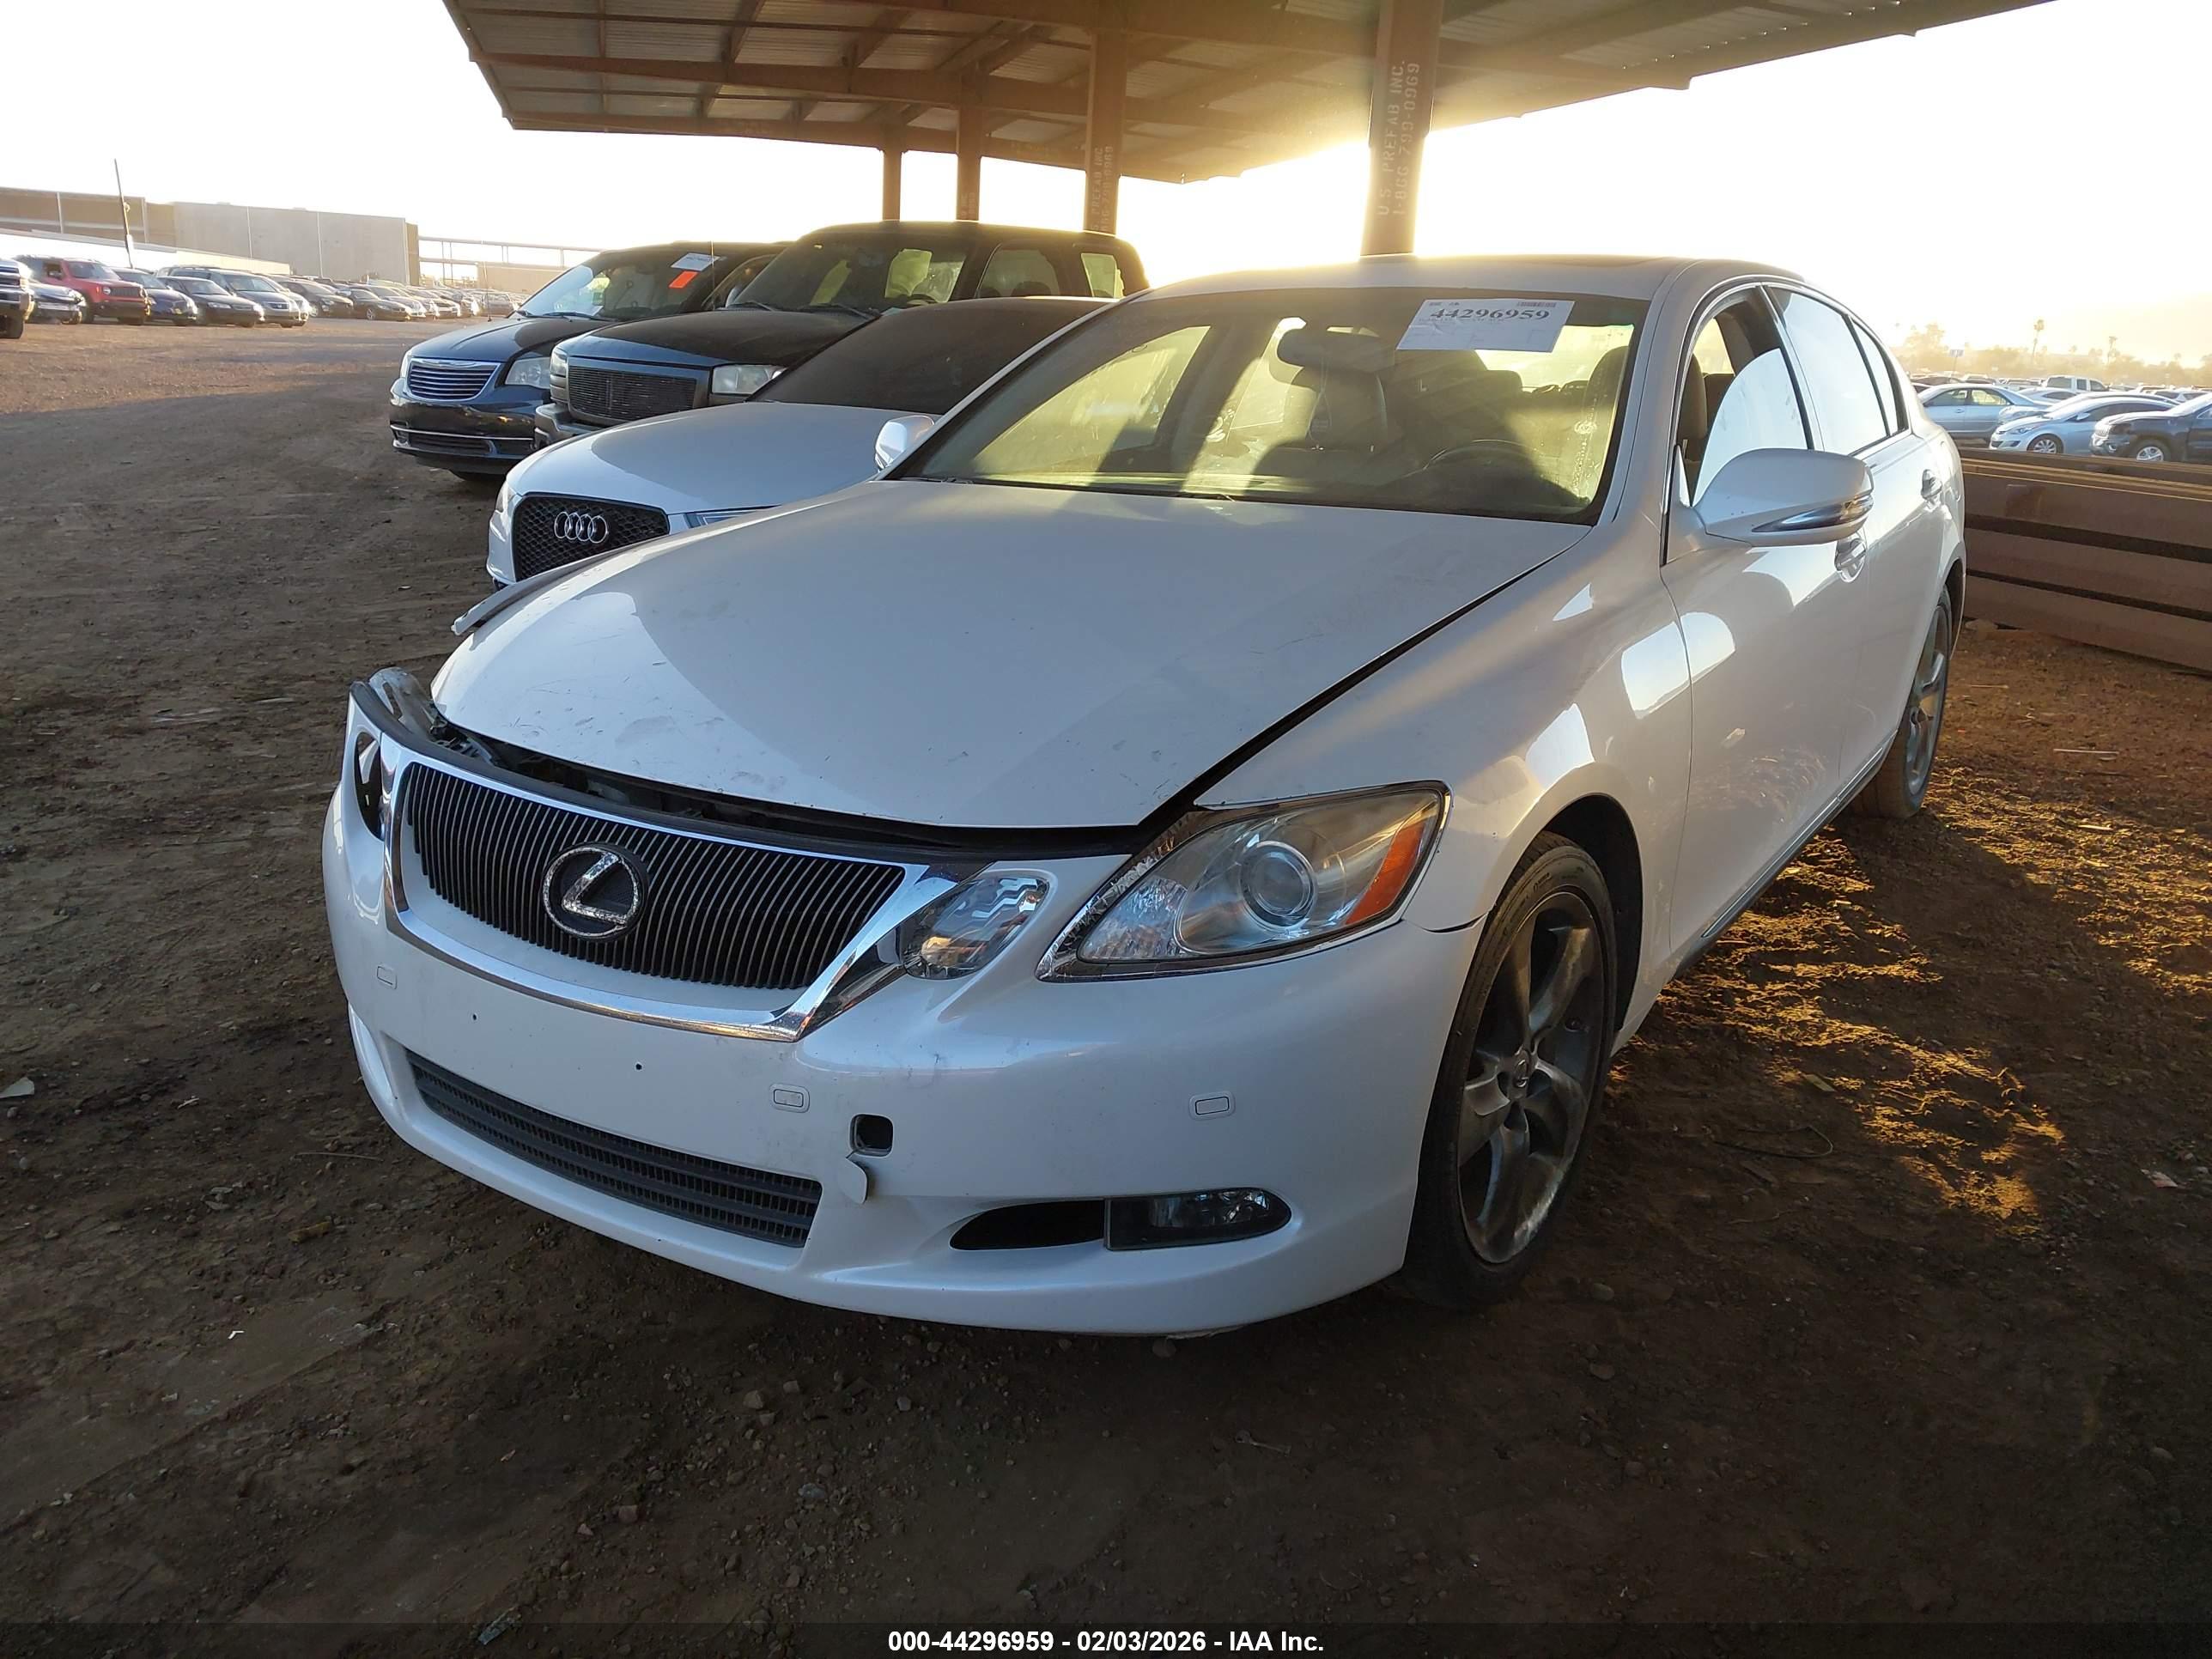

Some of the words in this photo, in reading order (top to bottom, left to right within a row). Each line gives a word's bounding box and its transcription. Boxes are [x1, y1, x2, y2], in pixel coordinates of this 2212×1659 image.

[1389, 60, 1406, 94] INC.
[1400, 63, 1420, 156] 799-0969
[1382, 104, 1401, 173] PREFAB
[1392, 165, 1409, 216] 1-866
[1430, 307, 1550, 320] 44296959
